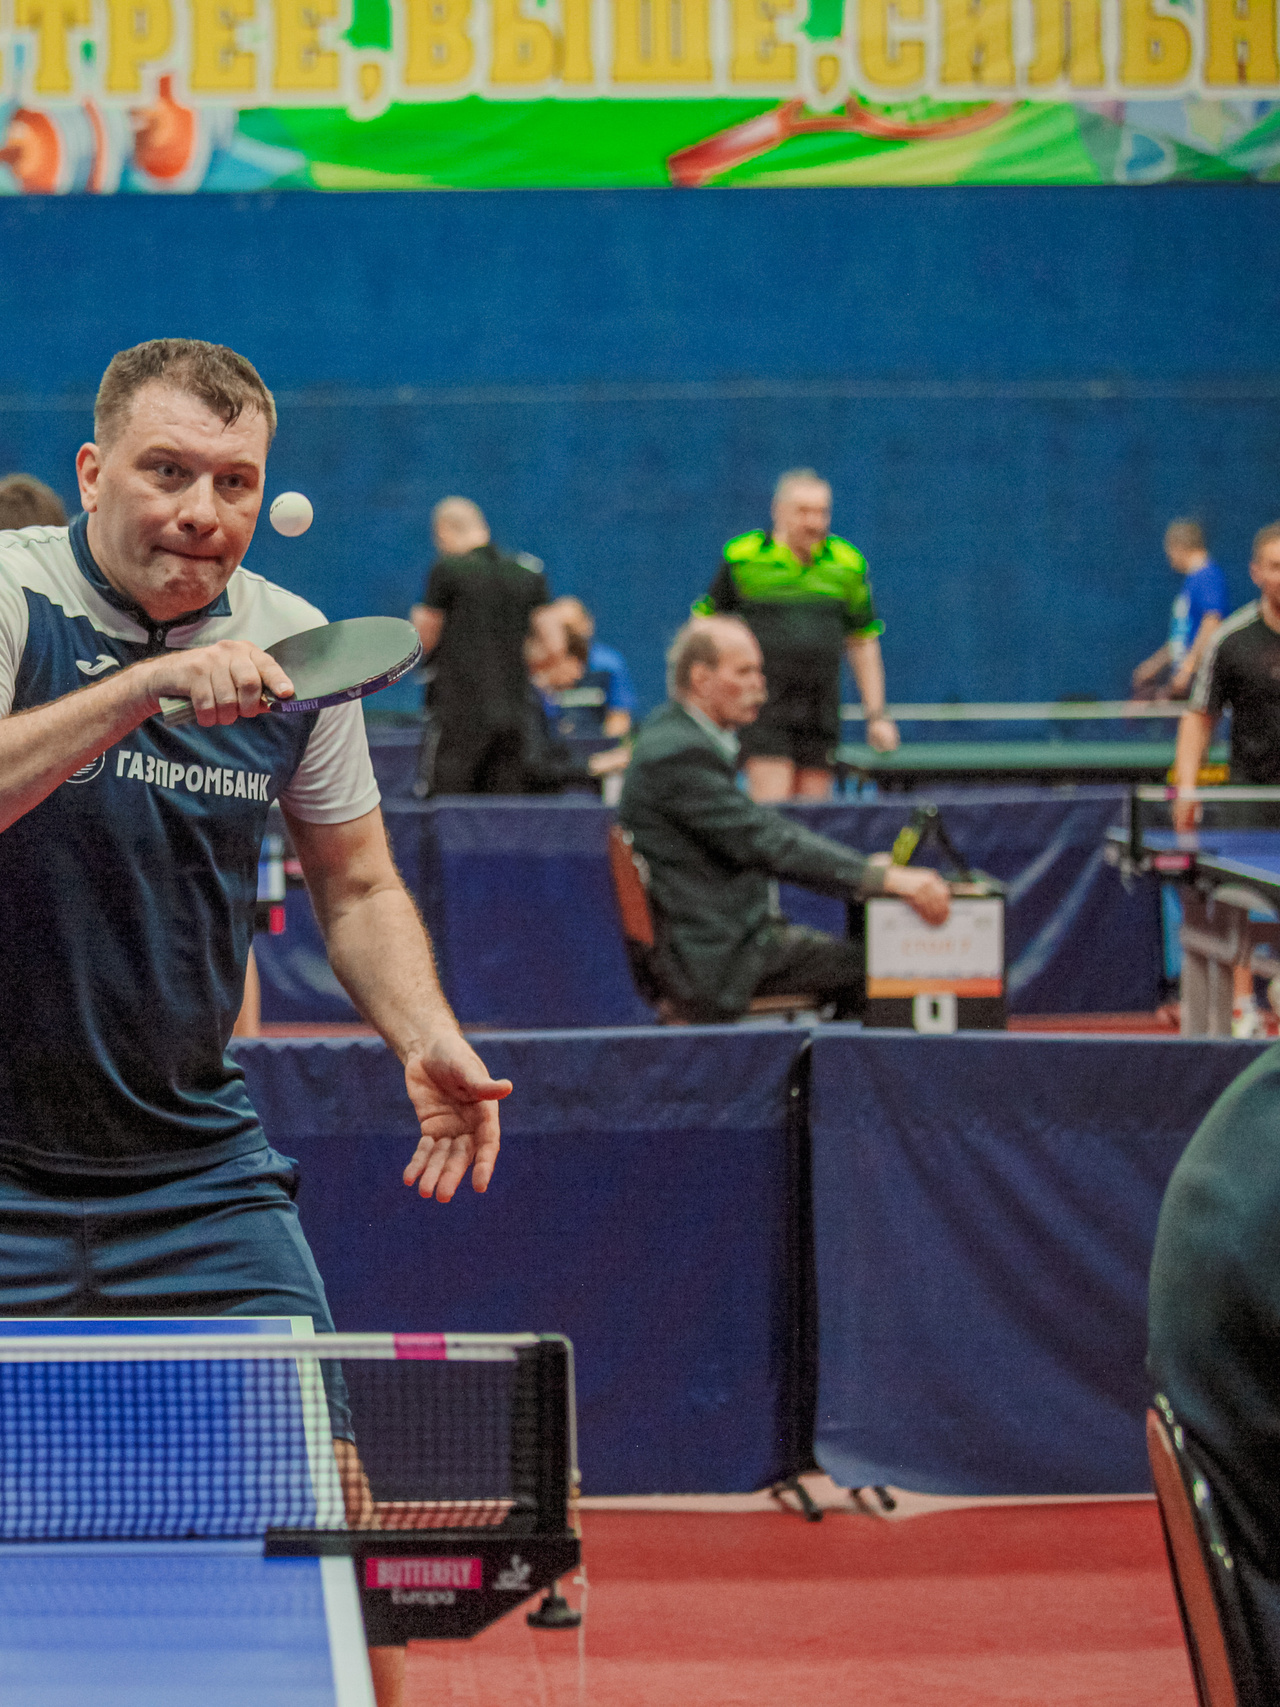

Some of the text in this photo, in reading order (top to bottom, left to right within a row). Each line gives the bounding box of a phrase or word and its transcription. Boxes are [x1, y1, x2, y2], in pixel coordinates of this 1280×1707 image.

[281, 699, 319, 712] BUTTERFLY
[116, 749, 271, 802] ГАЗПРОМБАНК
[377, 1559, 472, 1587] BUTTERFLY
